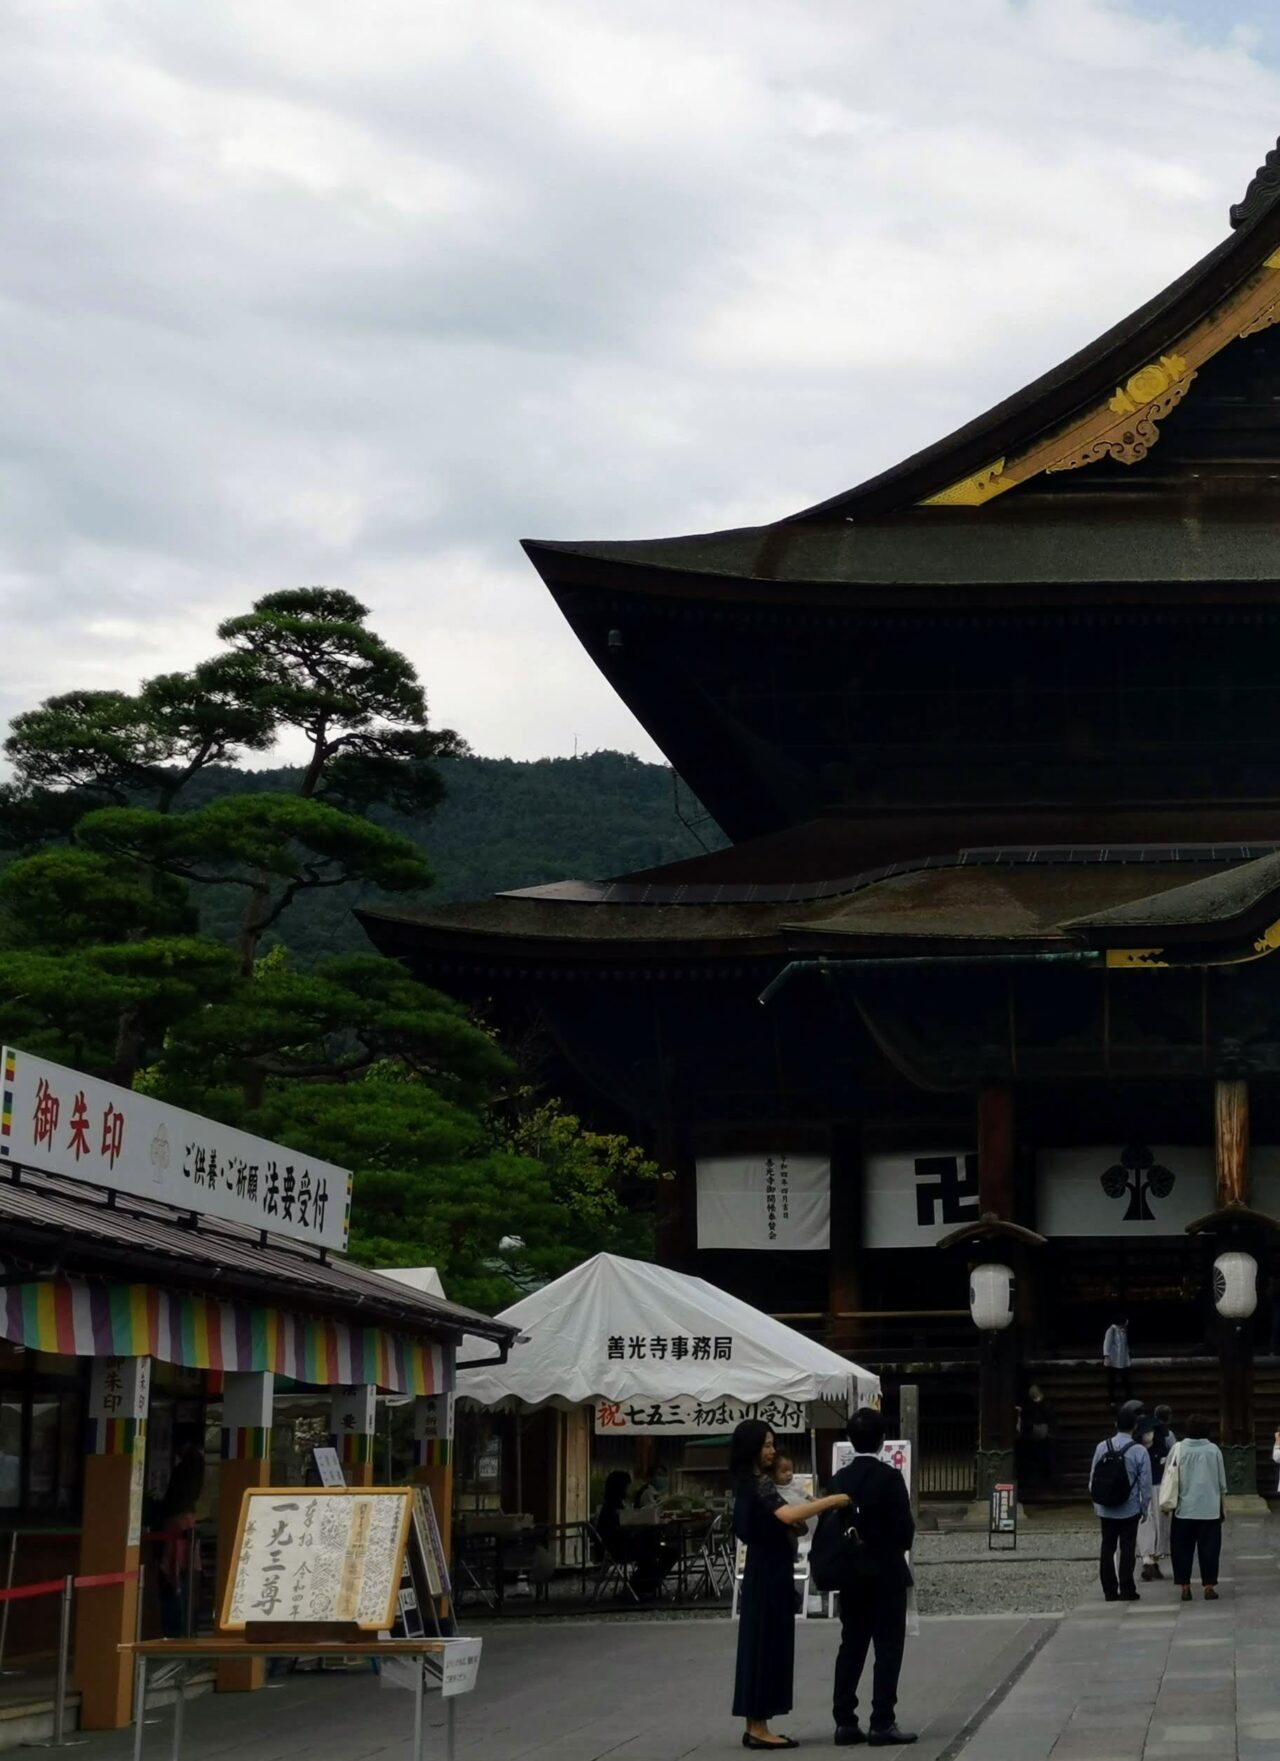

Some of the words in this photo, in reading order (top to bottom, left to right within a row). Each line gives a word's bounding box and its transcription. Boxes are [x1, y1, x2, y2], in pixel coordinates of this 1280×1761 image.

[33, 1077, 125, 1170] 御朱印
[183, 1142, 259, 1202] ご供養・ご祈願
[263, 1161, 329, 1233] 法要受付
[607, 1336, 733, 1361] 善光寺事務局
[251, 1502, 299, 1615] 一光三尊
